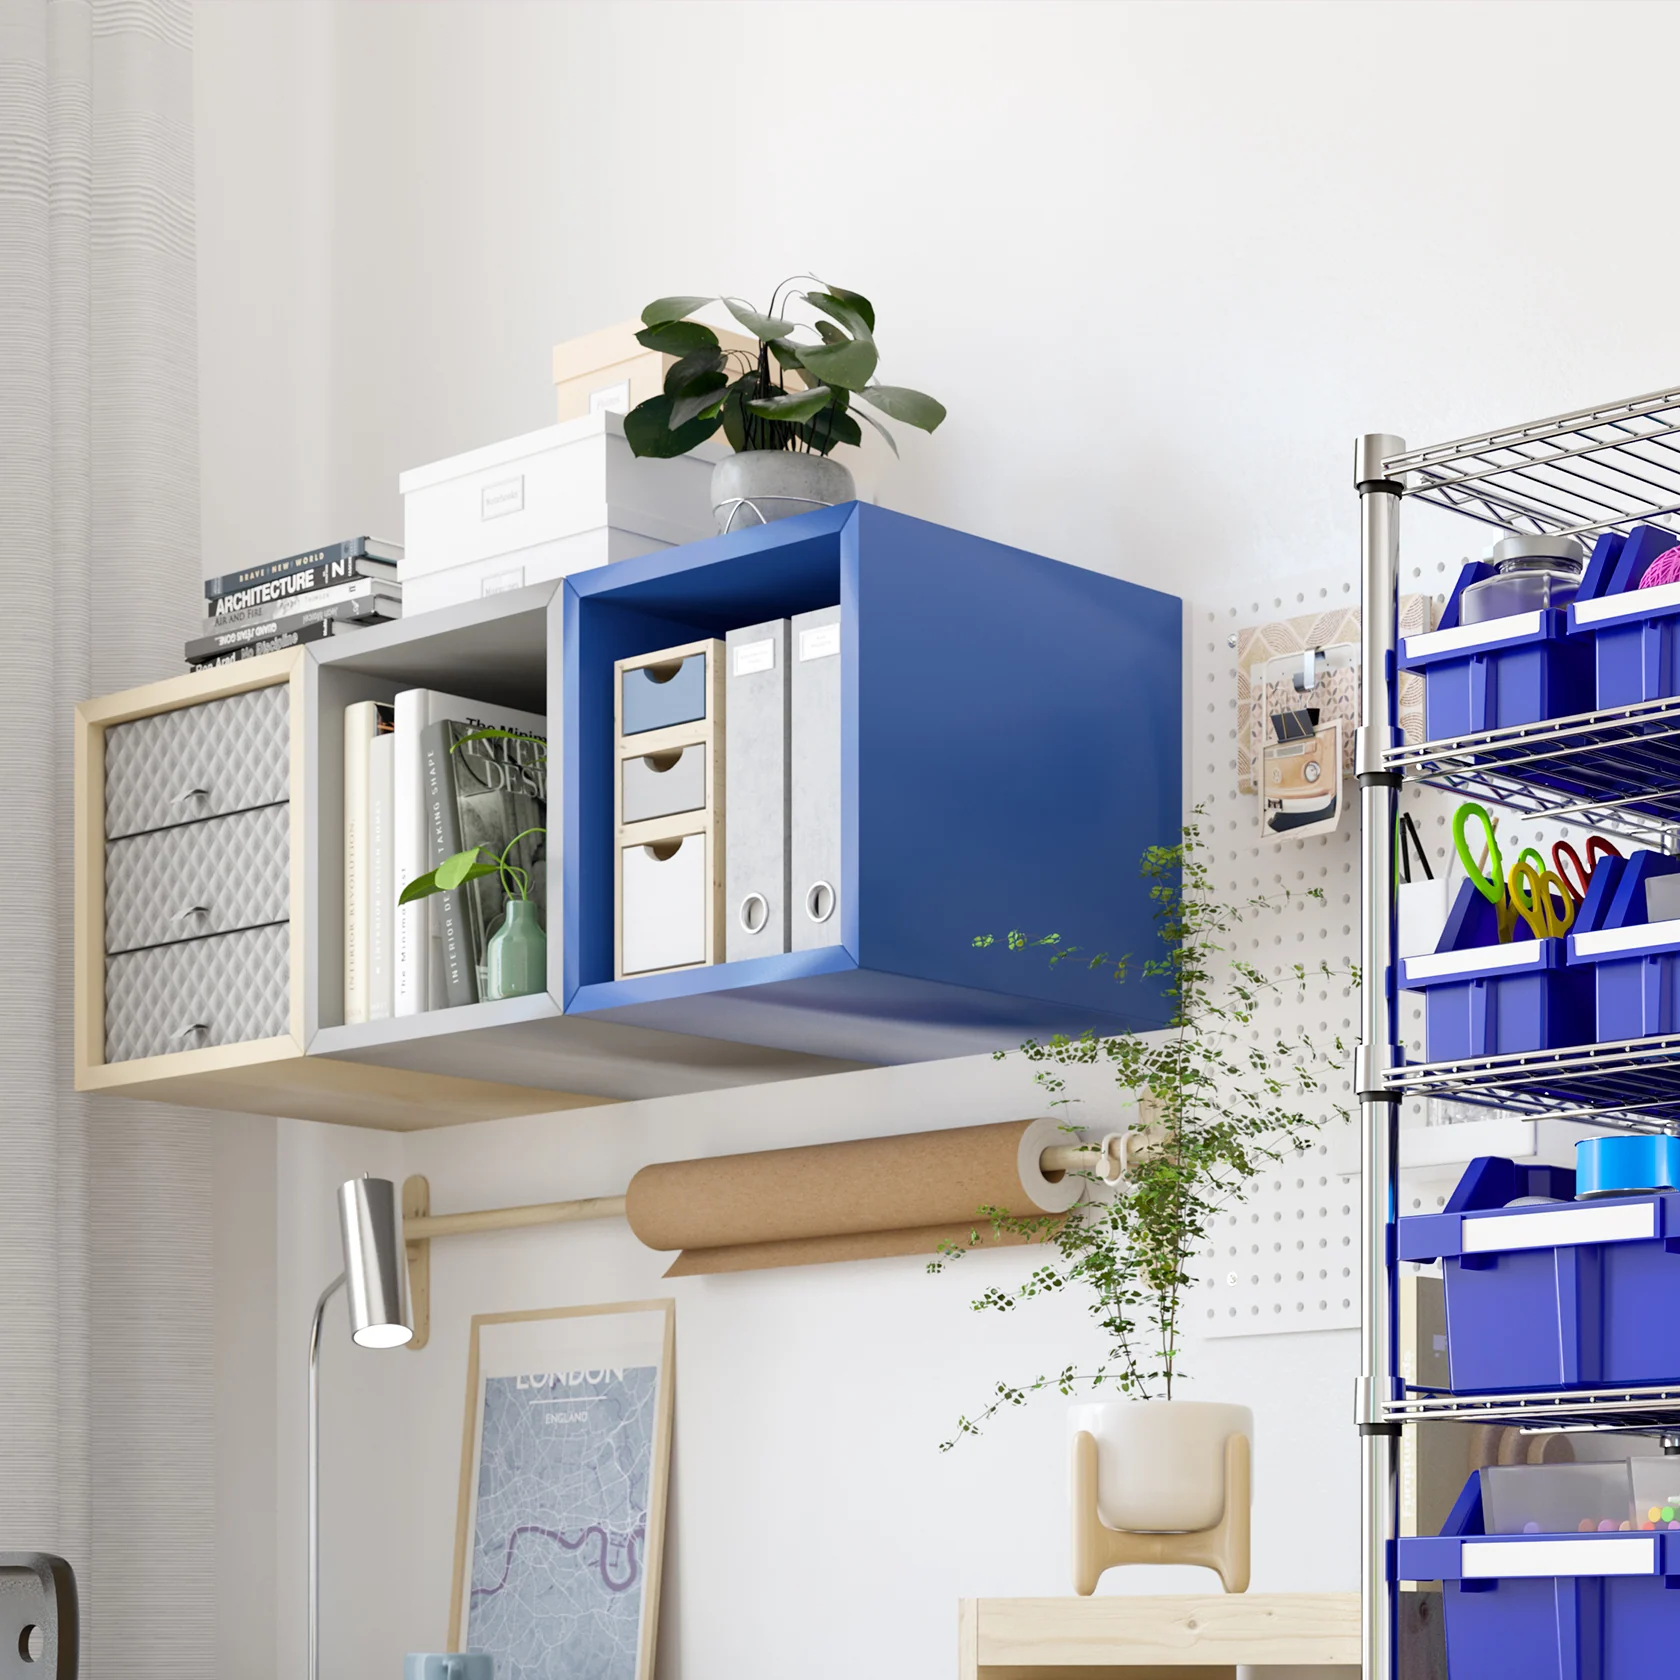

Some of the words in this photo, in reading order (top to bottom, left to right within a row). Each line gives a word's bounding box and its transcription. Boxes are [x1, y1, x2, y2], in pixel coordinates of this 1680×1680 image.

[239, 569, 265, 582] BRAVE
[271, 562, 290, 574] NEW
[295, 552, 325, 567] WORLD
[216, 568, 315, 617] ARCHITECTURE
[214, 616, 227, 627] AIR
[228, 611, 246, 623] AND
[247, 607, 263, 620] FIRE
[427, 750, 439, 796] SHAPE
[432, 802, 444, 853] TAKING
[445, 918, 459, 984] INTERIOR
[545, 1410, 588, 1425] ENGLAND
